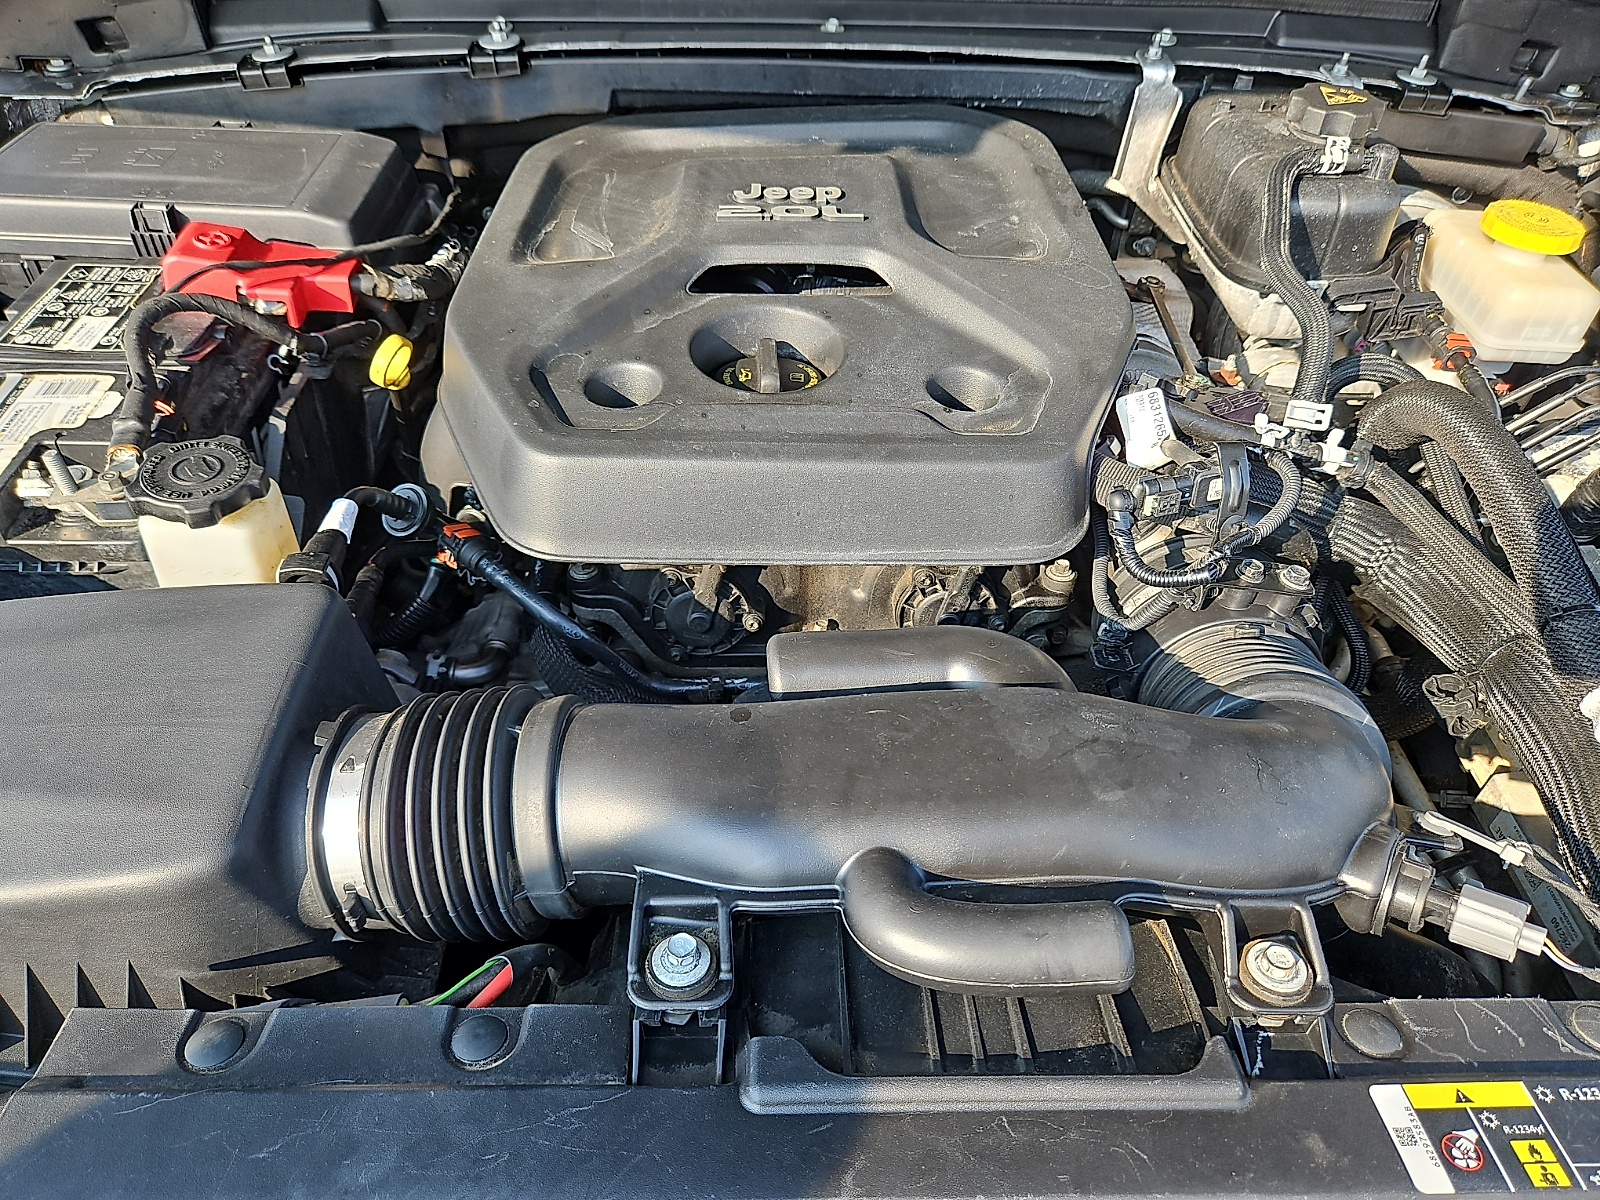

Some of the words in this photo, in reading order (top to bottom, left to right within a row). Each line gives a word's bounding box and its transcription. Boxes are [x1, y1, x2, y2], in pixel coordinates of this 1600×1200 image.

[733, 183, 843, 206] Jeep
[716, 204, 866, 223] 2.0L
[1148, 391, 1168, 441] 6831265
[1404, 1106, 1441, 1168] 68297583AB
[1502, 1124, 1546, 1137] R-1234yf
